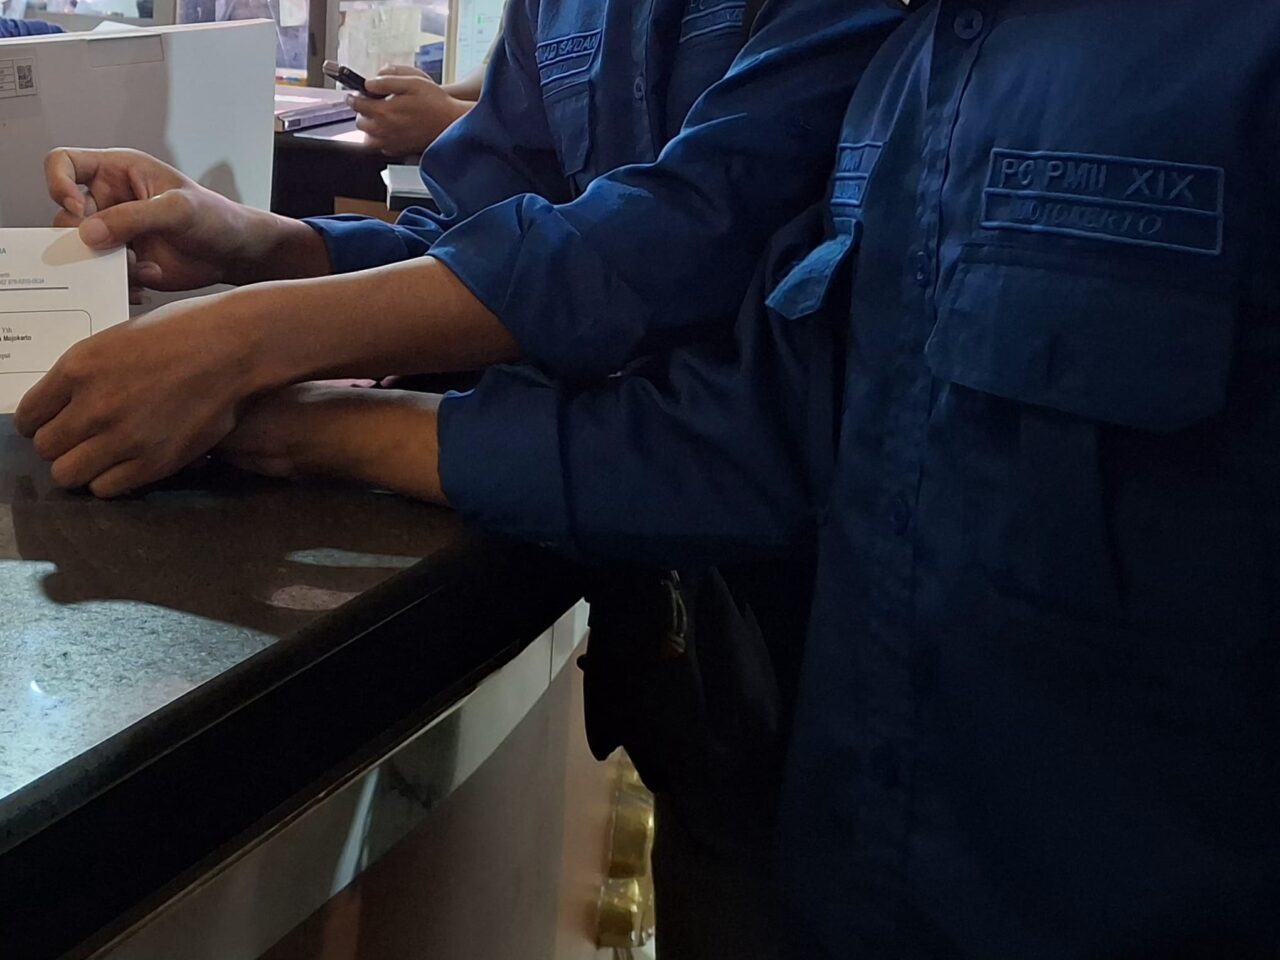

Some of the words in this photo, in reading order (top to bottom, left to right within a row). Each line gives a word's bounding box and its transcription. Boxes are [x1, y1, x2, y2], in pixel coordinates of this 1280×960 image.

[1000, 158, 1034, 188] PC
[1046, 160, 1107, 189] PMII
[1122, 167, 1195, 202] XIX
[3, 335, 32, 343] Mojokerto
